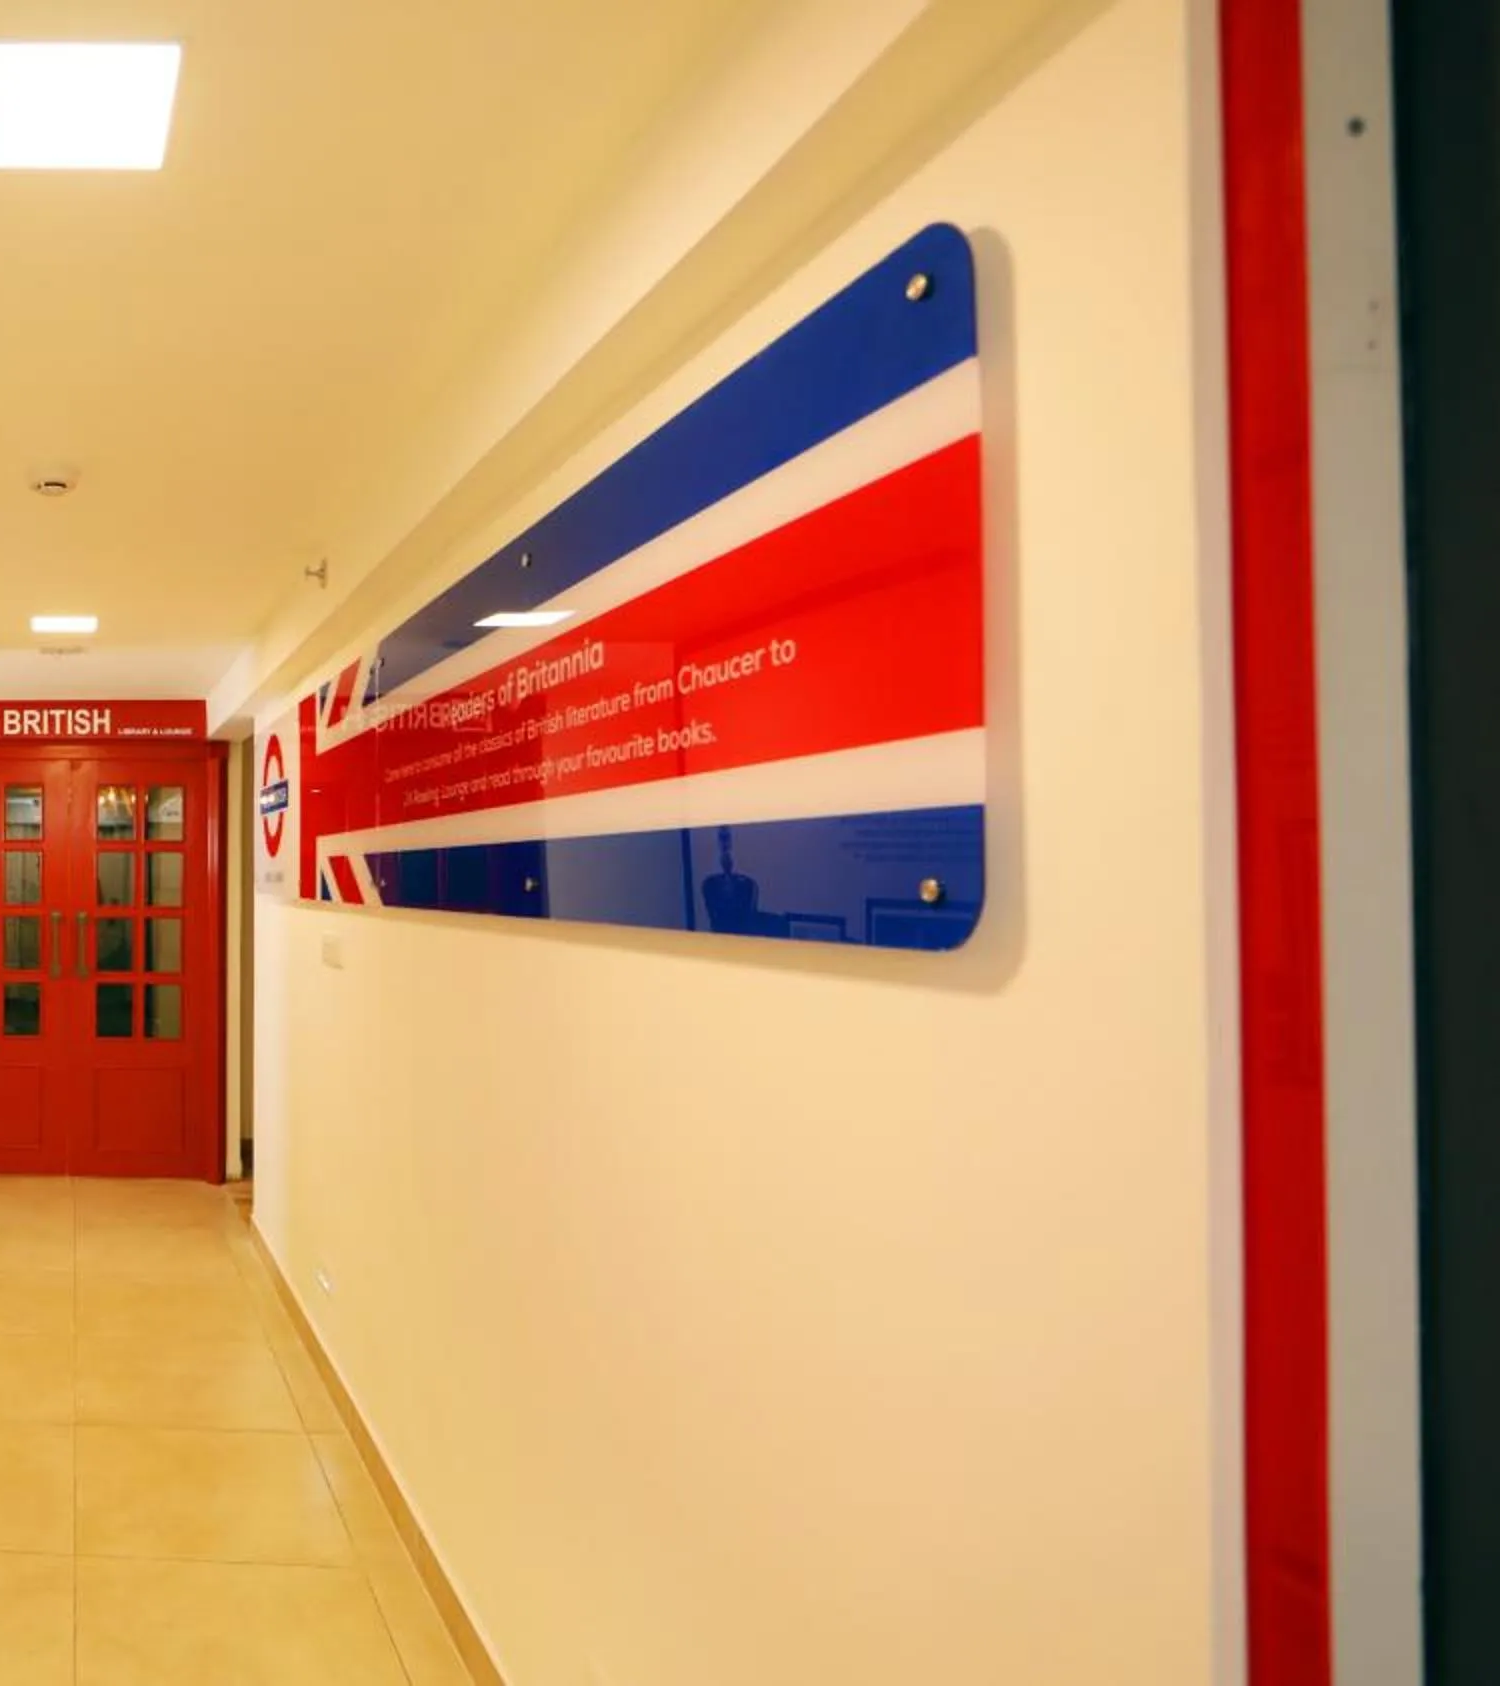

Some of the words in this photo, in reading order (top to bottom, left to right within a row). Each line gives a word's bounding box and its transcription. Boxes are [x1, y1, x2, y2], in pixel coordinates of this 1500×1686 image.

[498, 671, 514, 707] of
[516, 637, 605, 700] Britannia
[527, 711, 564, 741] British
[565, 692, 631, 729] literature
[633, 679, 674, 708] from
[677, 647, 766, 695] Chaucer
[769, 638, 797, 667] to
[3, 708, 111, 735] BRITISH
[489, 771, 511, 789] read
[512, 755, 554, 785] through
[555, 751, 585, 781] your
[586, 732, 653, 768] favourite
[657, 718, 718, 753] books.
